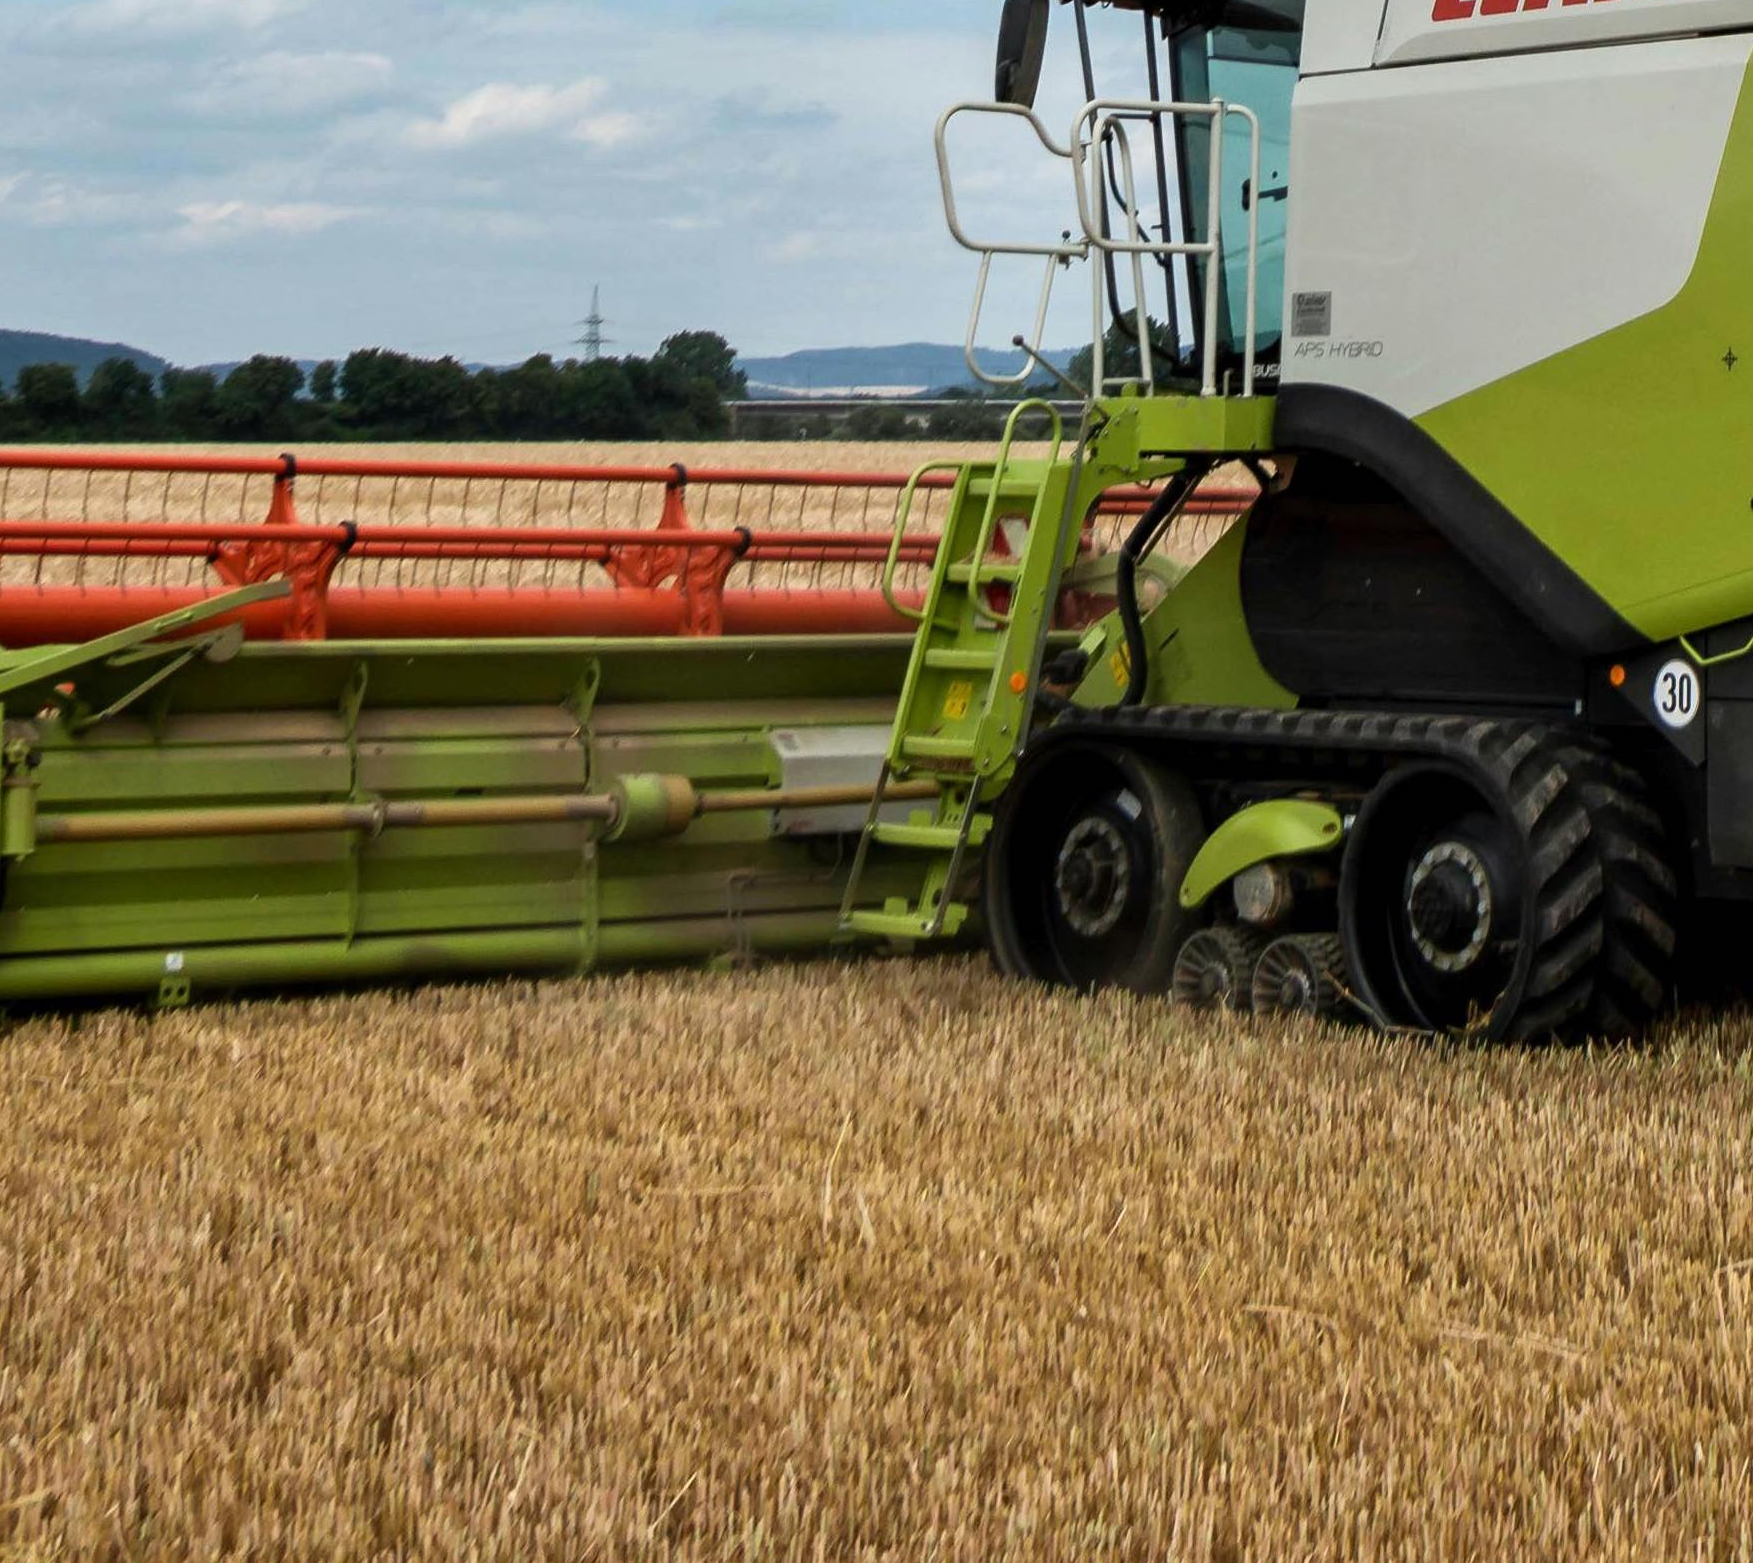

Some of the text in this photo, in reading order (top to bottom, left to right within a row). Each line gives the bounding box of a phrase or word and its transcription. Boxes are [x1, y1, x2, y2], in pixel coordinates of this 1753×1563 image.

[1294, 340, 1384, 358] APS HYBRID
[1662, 672, 1692, 714] 30
